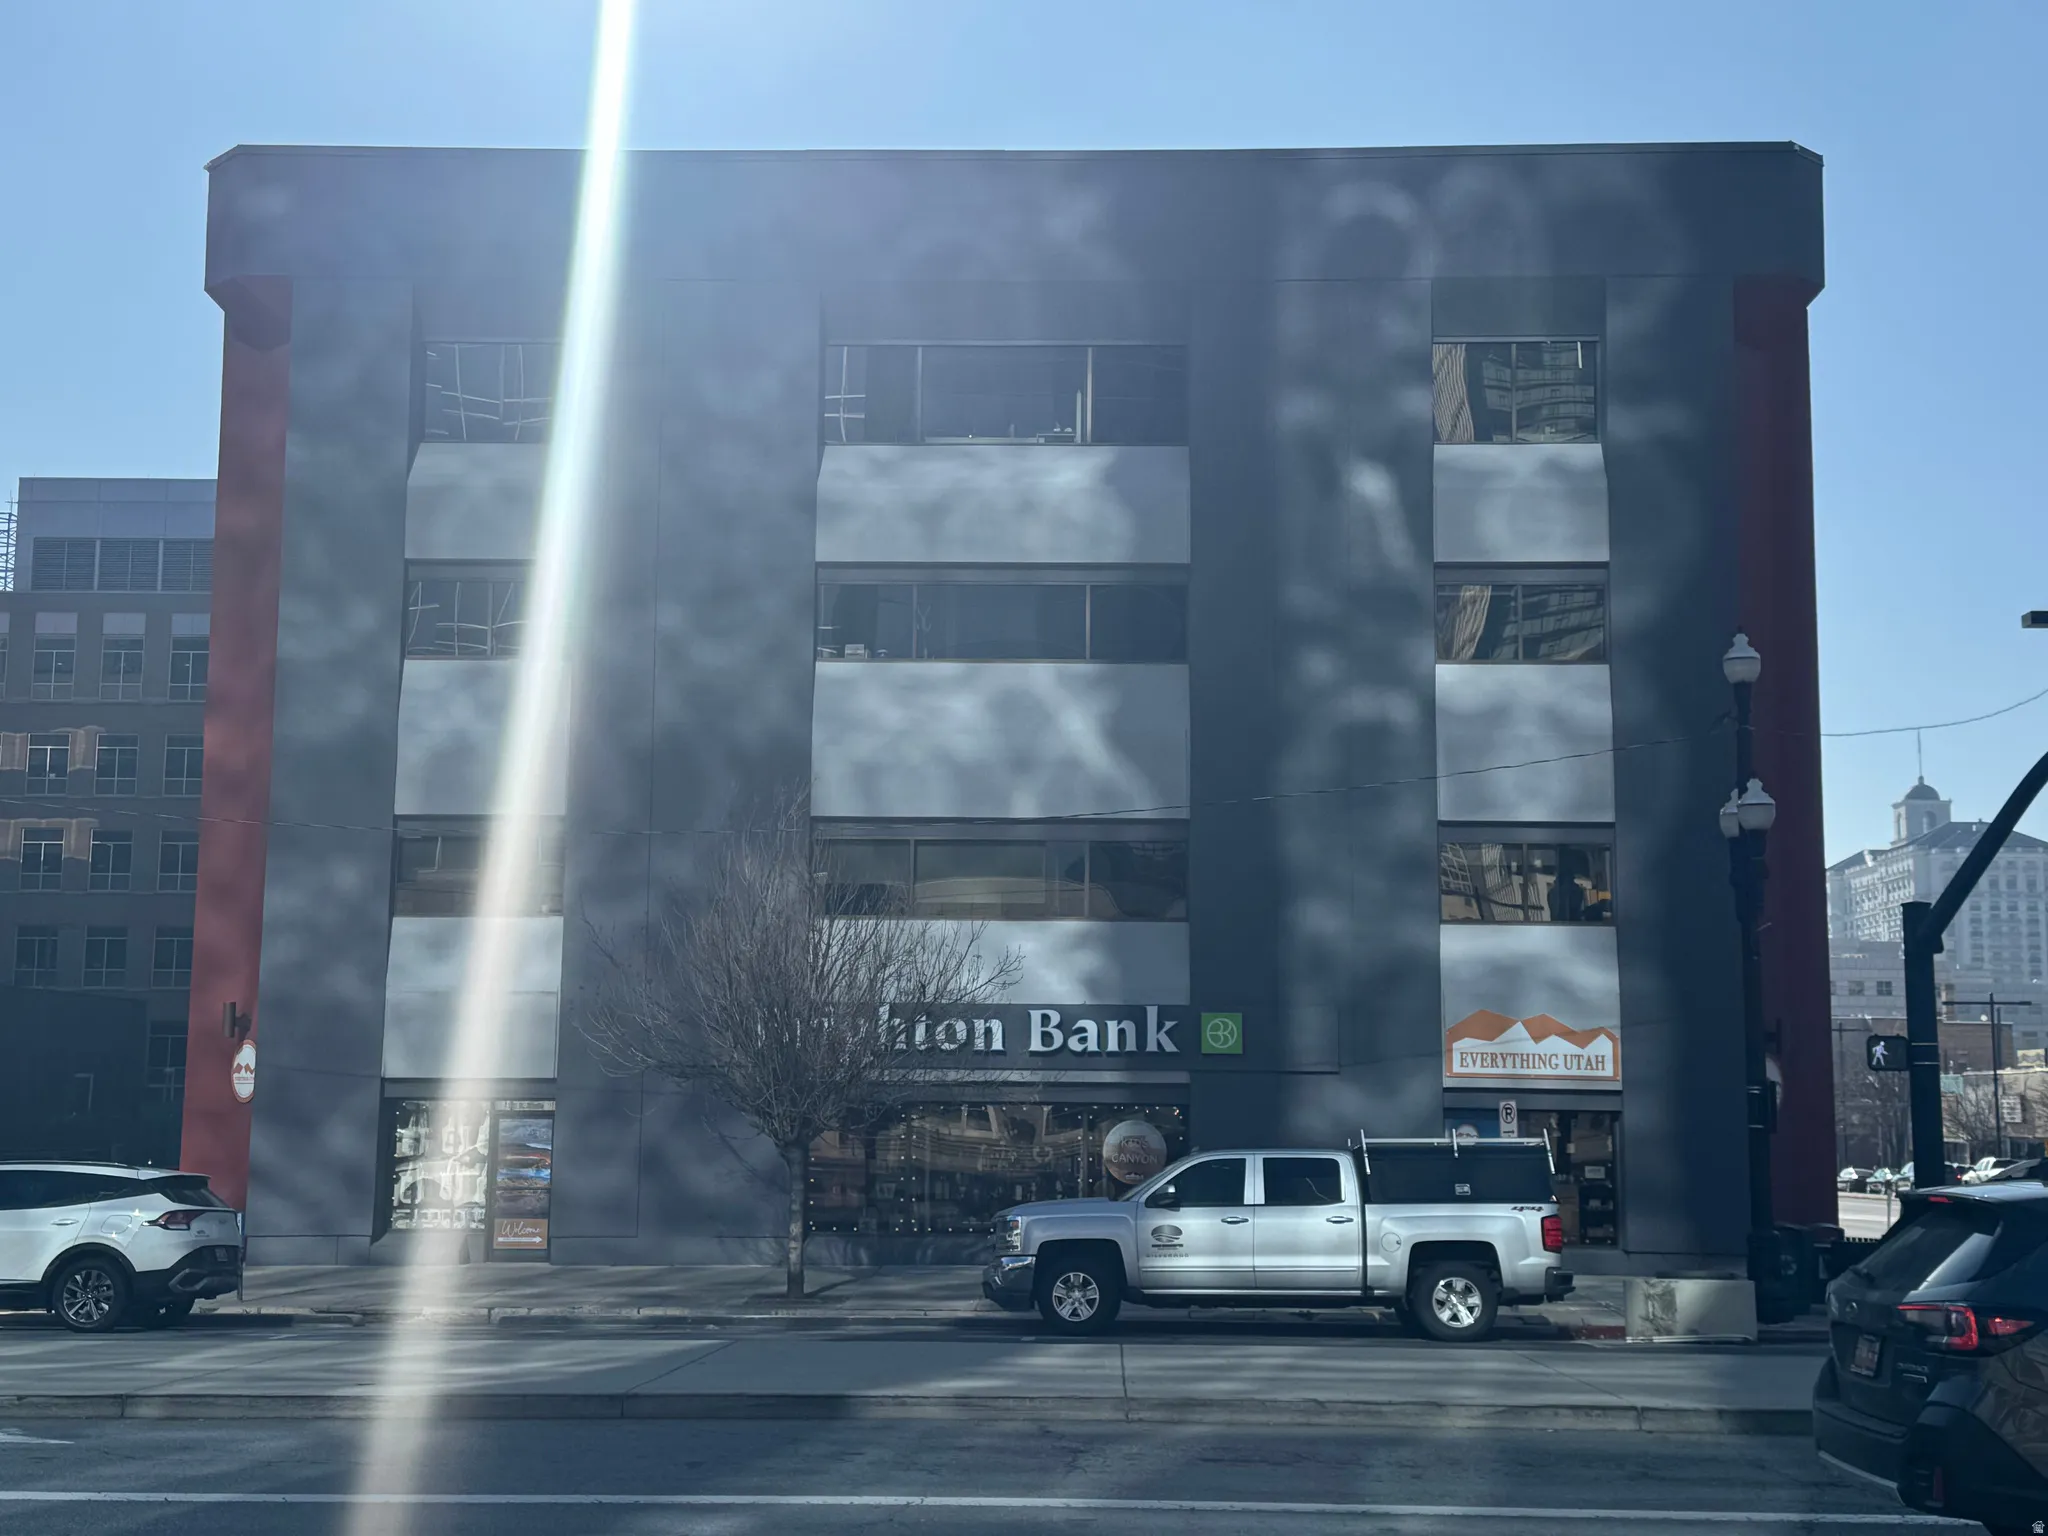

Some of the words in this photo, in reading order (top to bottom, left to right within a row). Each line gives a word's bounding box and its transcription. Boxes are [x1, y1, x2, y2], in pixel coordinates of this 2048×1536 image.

[1028, 1005, 1180, 1053] Bank
[1459, 1051, 1559, 1070] EVERYTHING
[1564, 1053, 1607, 1071] UTAH
[1111, 1152, 1158, 1164] CANYON
[501, 1220, 541, 1237] Welcome
